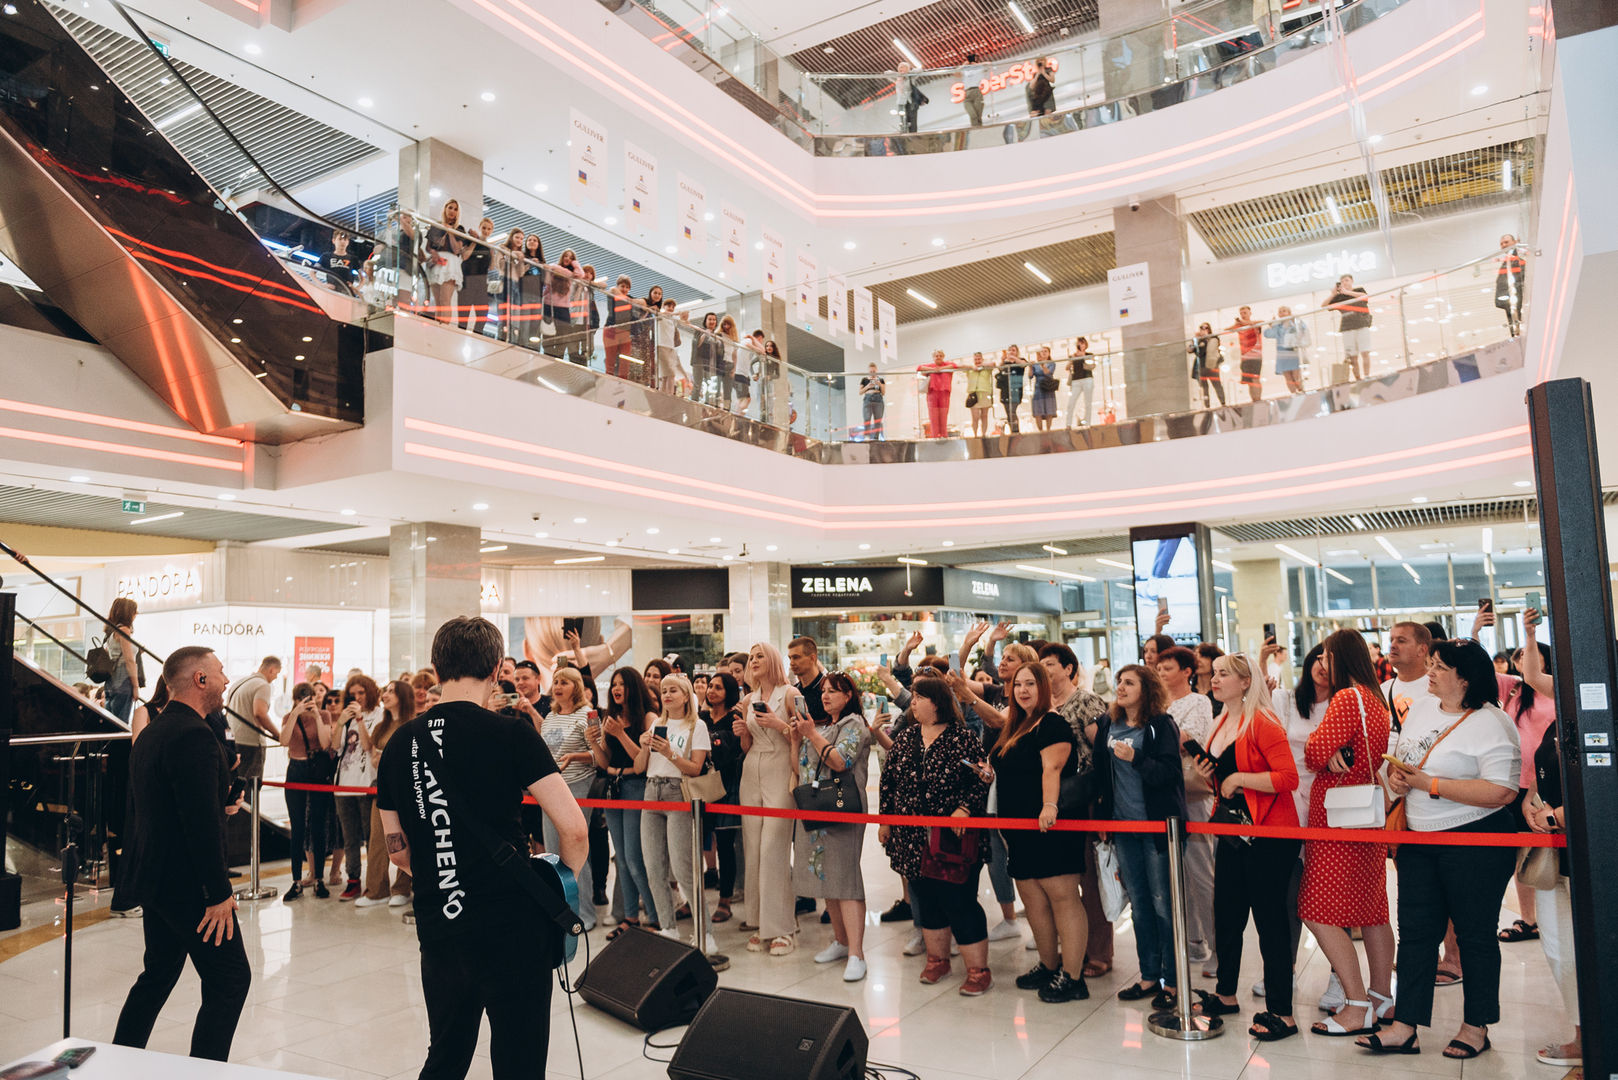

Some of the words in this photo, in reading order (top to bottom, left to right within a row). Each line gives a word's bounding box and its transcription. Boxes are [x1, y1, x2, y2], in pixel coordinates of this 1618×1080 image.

[950, 57, 1058, 103] SperSt
[573, 119, 604, 143] GULLIVER
[627, 151, 654, 172] GULLIVER
[680, 182, 704, 200] GULLIVER
[330, 258, 351, 267] EA7
[1266, 249, 1377, 289] Bershka
[1112, 270, 1144, 282] GULLIVER
[118, 571, 196, 600] PANDORA
[801, 577, 873, 593] ZELENA
[971, 580, 999, 597] ZELENA
[193, 622, 265, 636] PANDORA
[299, 653, 331, 661] ЗНИЖКИ
[411, 761, 420, 780] Ivan
[413, 780, 427, 819] Lytvynov
